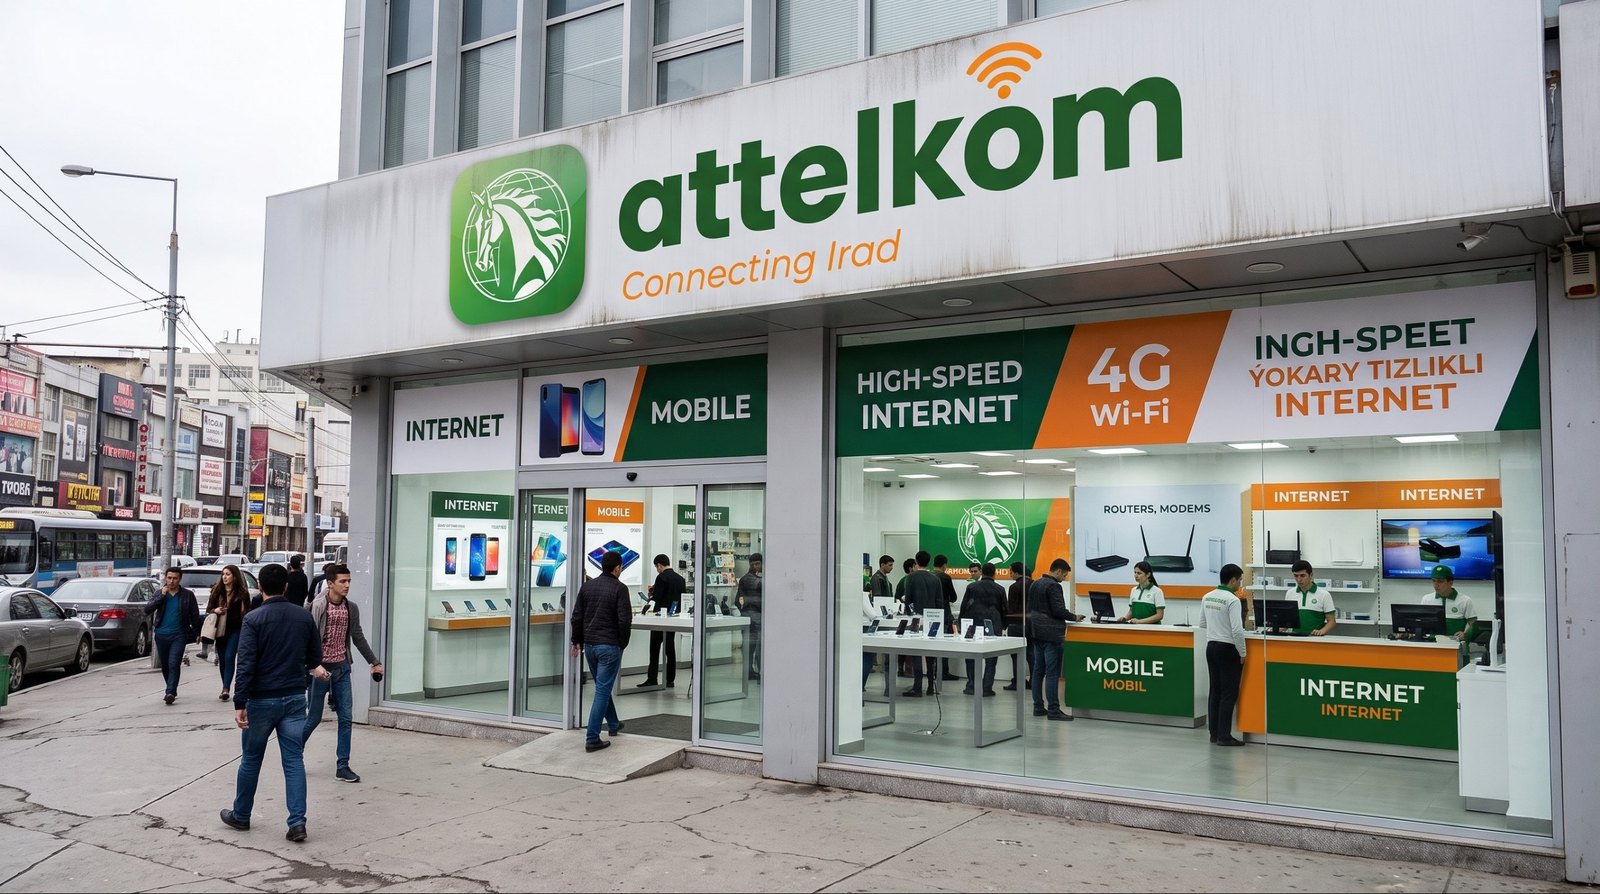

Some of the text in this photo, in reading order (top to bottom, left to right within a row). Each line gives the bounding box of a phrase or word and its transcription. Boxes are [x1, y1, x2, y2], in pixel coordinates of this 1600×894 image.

[619, 76, 1183, 252] attelkom
[623, 228, 902, 301] Connecting Irad
[1255, 318, 1476, 360] INGH-SPEET
[857, 360, 1023, 395] HIGH-SPEED
[1088, 344, 1170, 392] 4G
[1249, 352, 1483, 388] ÝOKARY TIZLIKLI
[651, 394, 751, 425] MOBILE
[862, 394, 1019, 430] INTERNET
[1090, 398, 1169, 427] Wi-Fi
[1275, 382, 1457, 418] INTERNET
[406, 413, 505, 442] INTERNET
[444, 499, 499, 512] INTERNET
[1274, 490, 1350, 503] INTERNET
[1400, 487, 1485, 501] INTERNET
[597, 507, 631, 517] MOBILE
[1103, 503, 1211, 515] ROUTERS, MODEMS
[1086, 656, 1164, 677] MOBILE
[1103, 678, 1147, 692] MOBIL
[1300, 678, 1425, 704] INTERNET
[1321, 703, 1403, 721] INTERNET
